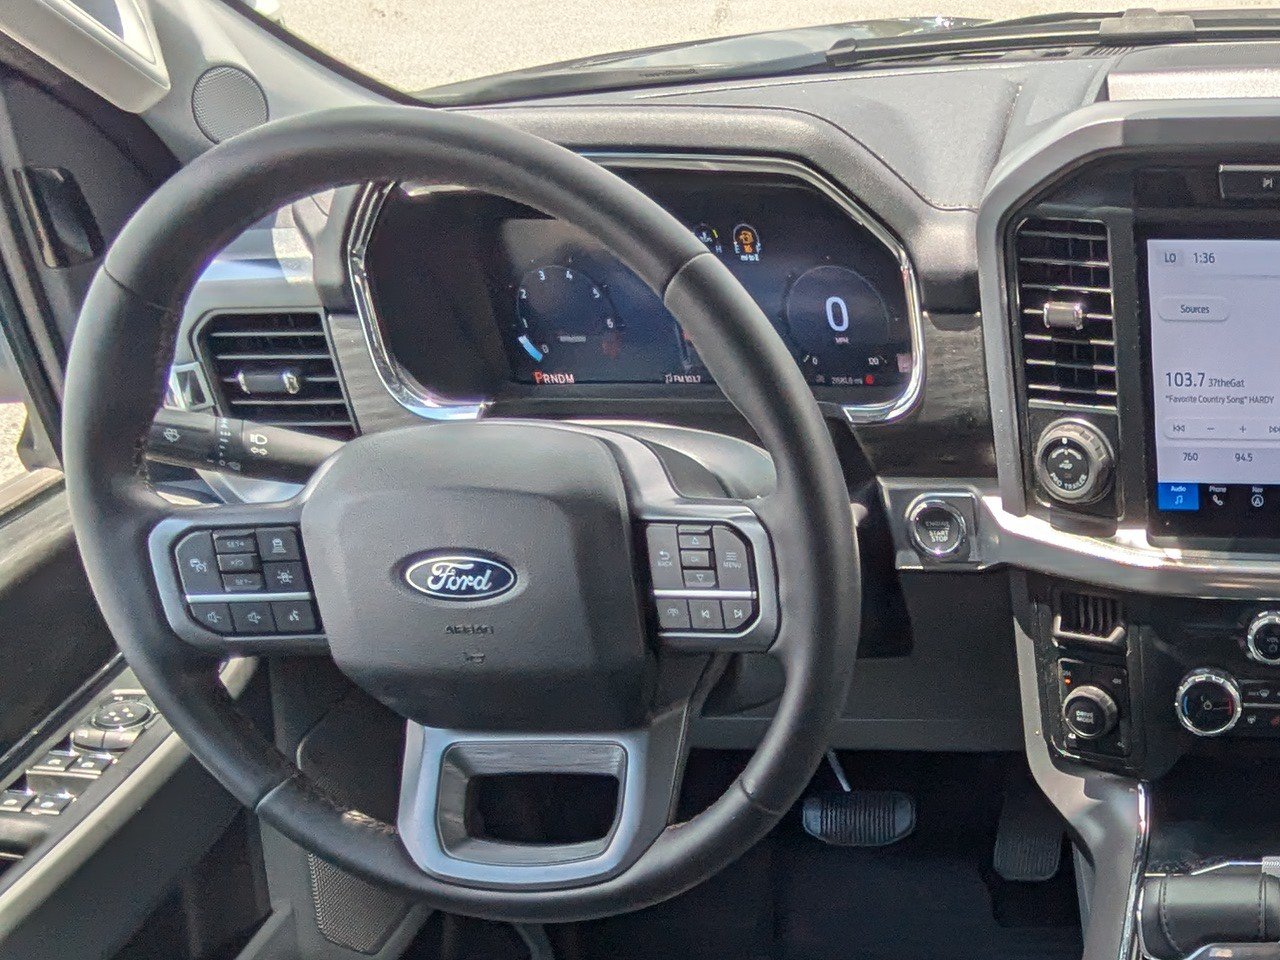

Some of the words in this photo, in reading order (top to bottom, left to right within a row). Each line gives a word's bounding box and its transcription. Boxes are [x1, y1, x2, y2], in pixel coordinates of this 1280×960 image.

[1164, 253, 1177, 263] LO
[1194, 253, 1215, 263] 1:36
[538, 270, 546, 281] 3
[565, 270, 573, 281] 4
[520, 288, 527, 300] 2
[592, 287, 600, 299] 5
[825, 296, 849, 332] 0
[1180, 304, 1210, 314] Sources
[606, 318, 614, 328] 6
[1166, 372, 1206, 387] 103.7
[1208, 378, 1245, 387] 37theGat
[1198, 394, 1225, 405] Country
[1248, 395, 1275, 404] HARDY
[1183, 452, 1198, 462] 760
[1235, 453, 1253, 462] 94.5
[1209, 485, 1227, 493] Phone
[427, 561, 493, 591] Ford
